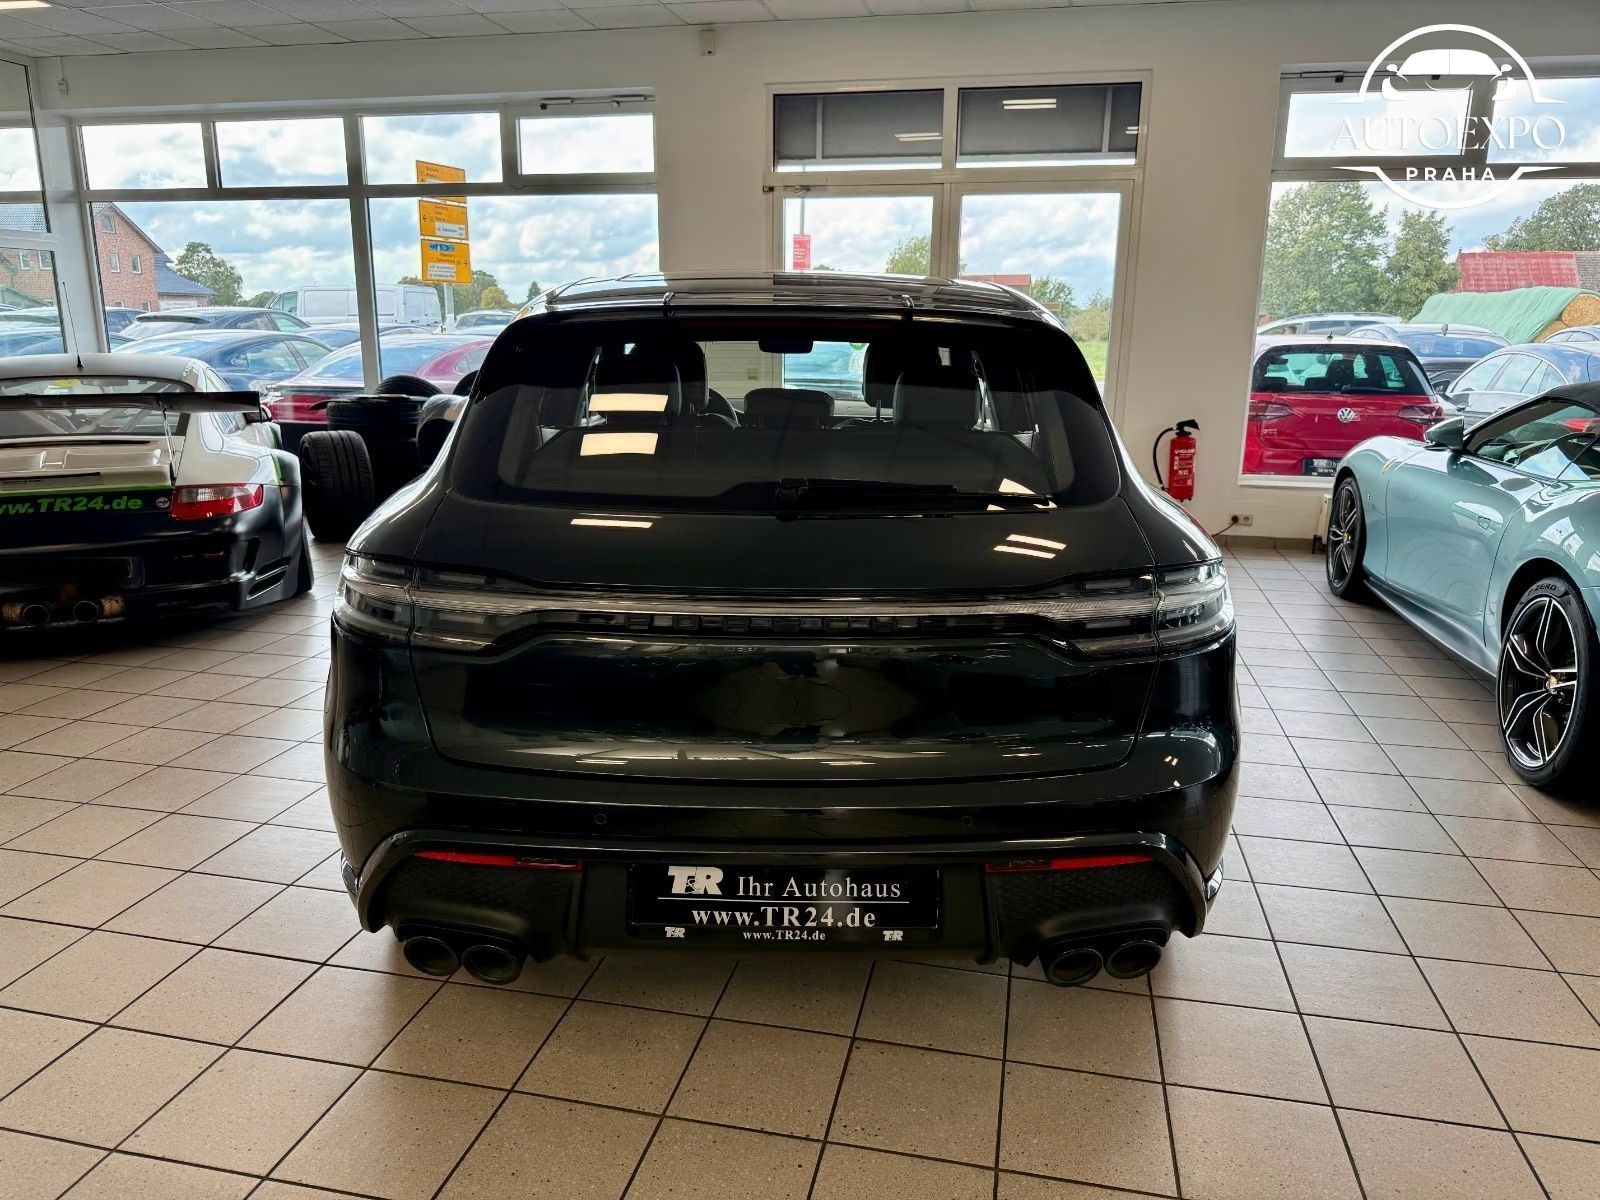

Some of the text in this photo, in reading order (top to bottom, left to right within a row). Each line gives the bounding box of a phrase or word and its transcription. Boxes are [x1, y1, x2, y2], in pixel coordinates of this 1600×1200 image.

[736, 876, 774, 897] Ihr
[781, 876, 901, 898] Autohaus
[691, 906, 876, 928] www.TR24.de
[743, 929, 827, 941] www.TR24.de
